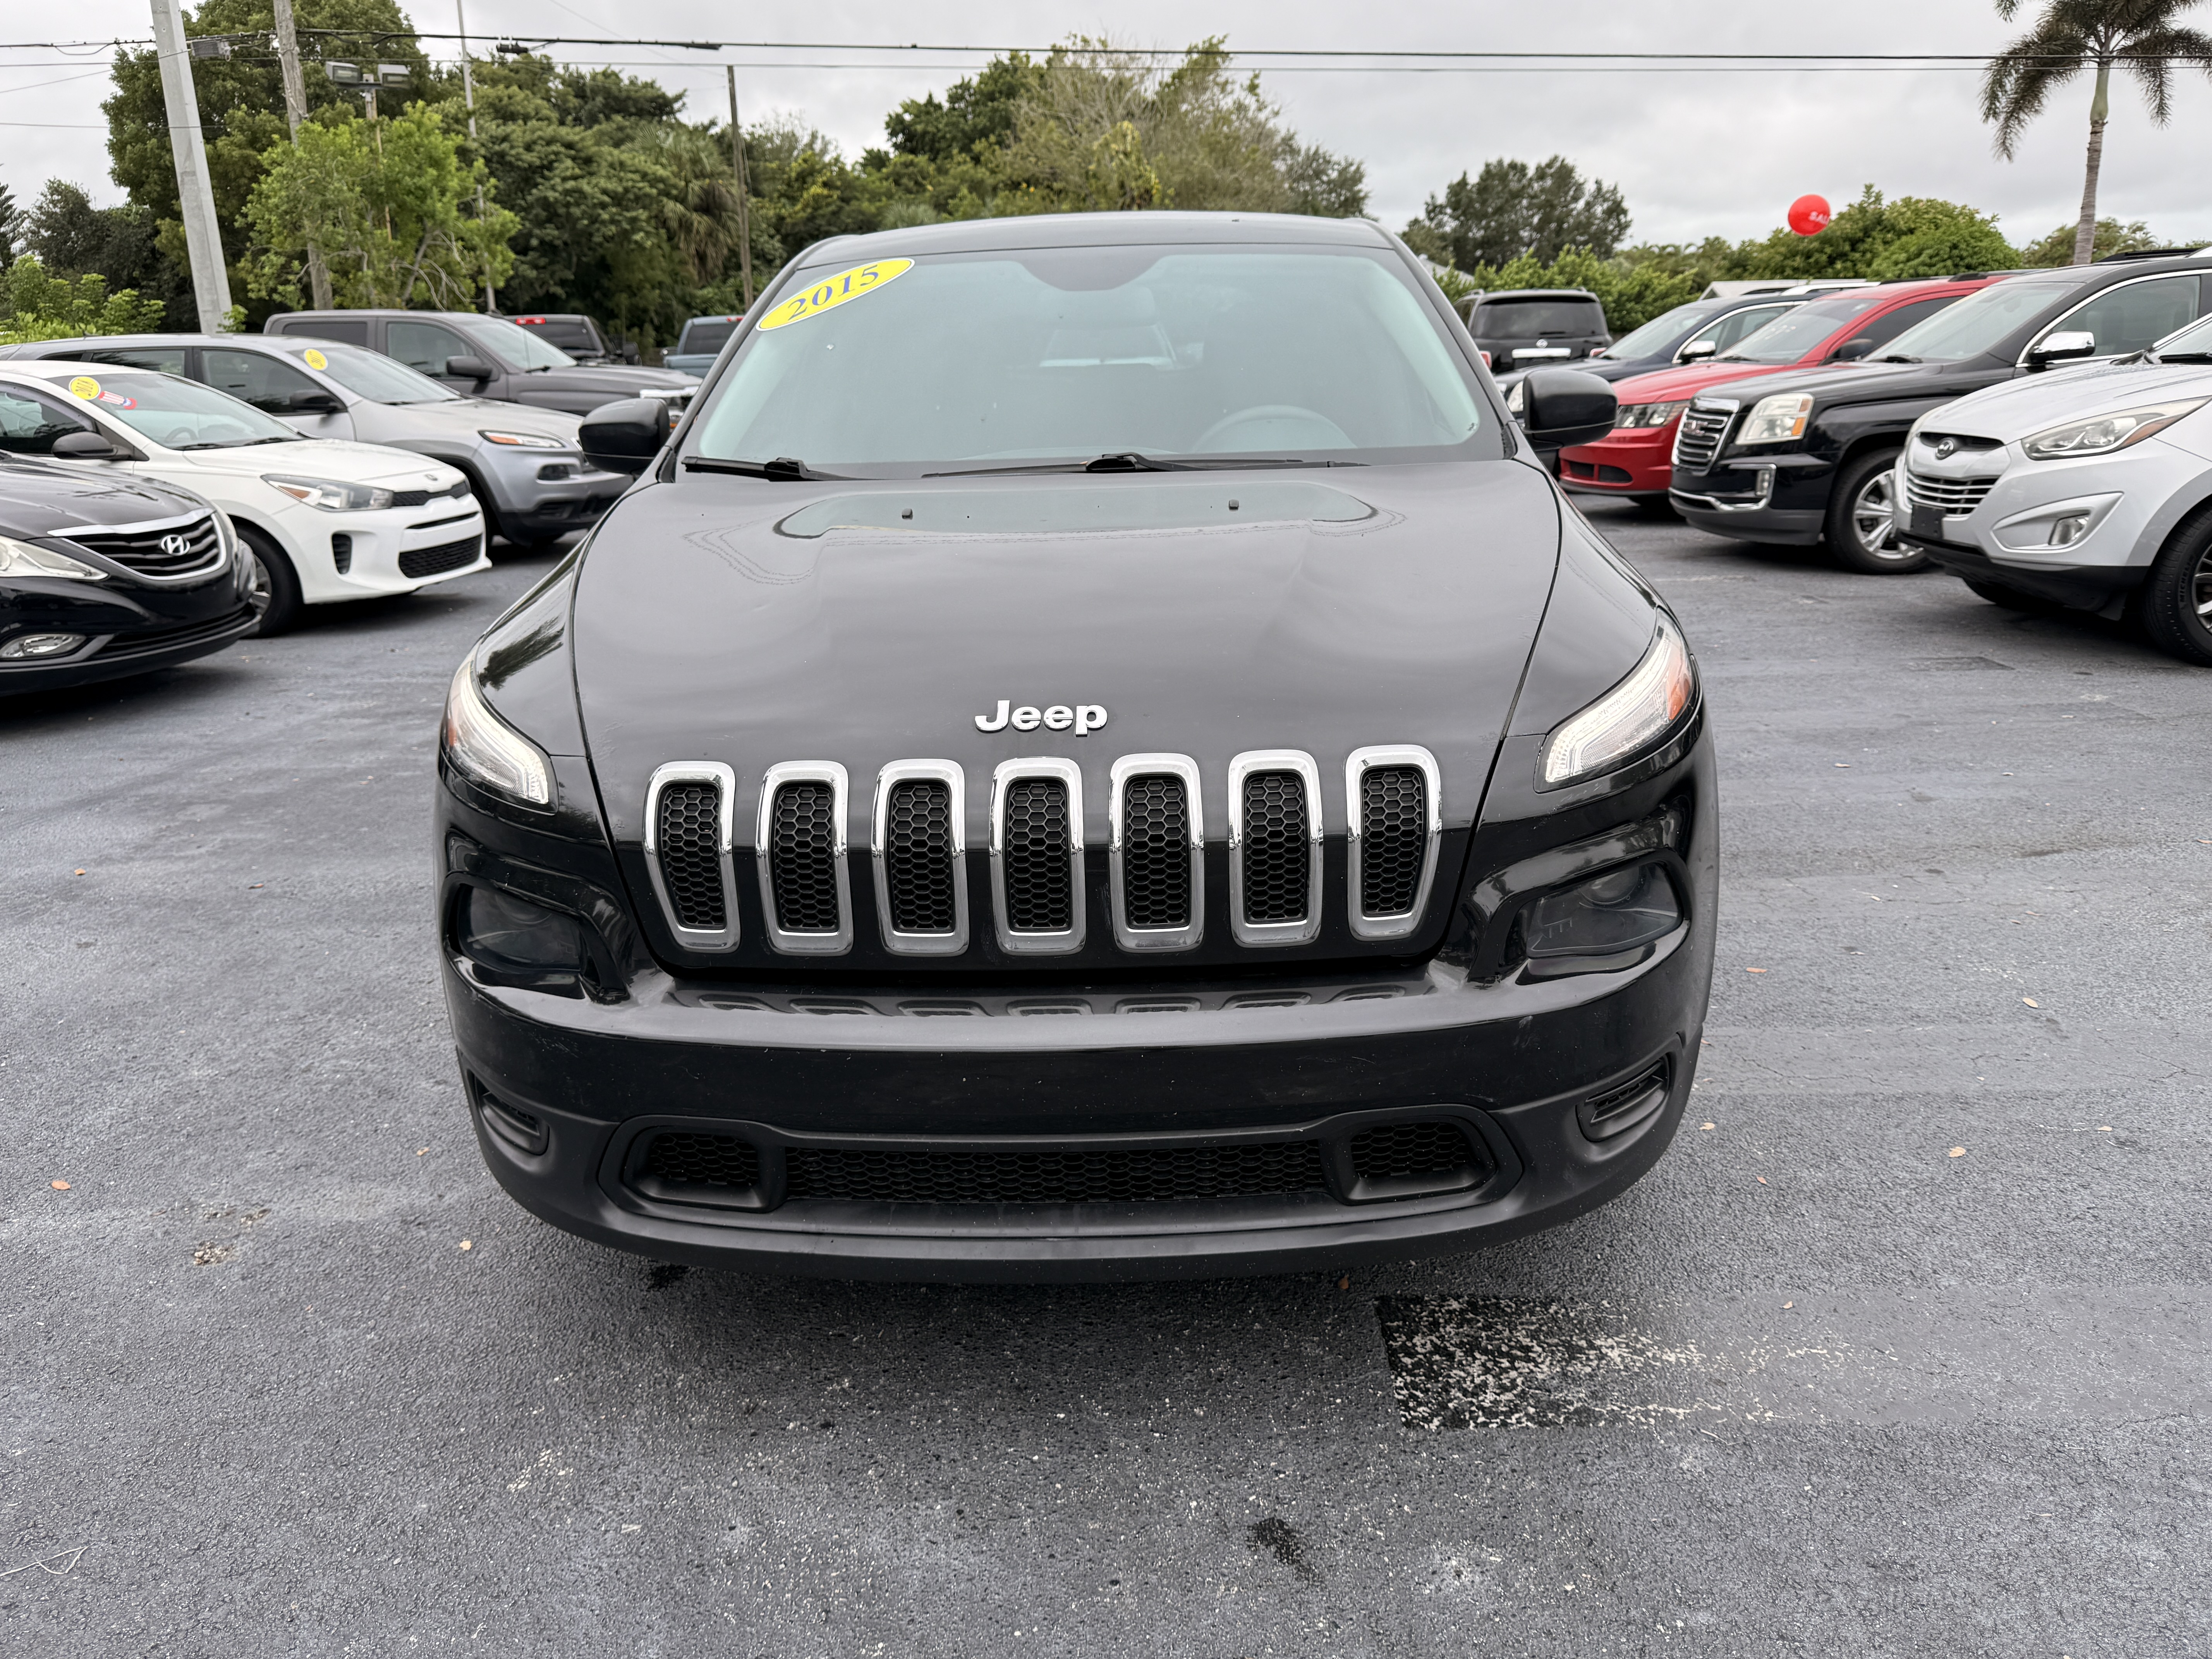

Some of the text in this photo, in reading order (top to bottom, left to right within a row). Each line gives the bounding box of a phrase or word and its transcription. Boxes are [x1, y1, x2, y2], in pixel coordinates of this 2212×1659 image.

[1808, 211, 1830, 225] SAL
[787, 264, 879, 321] 2015
[974, 699, 1108, 737] Jeep
